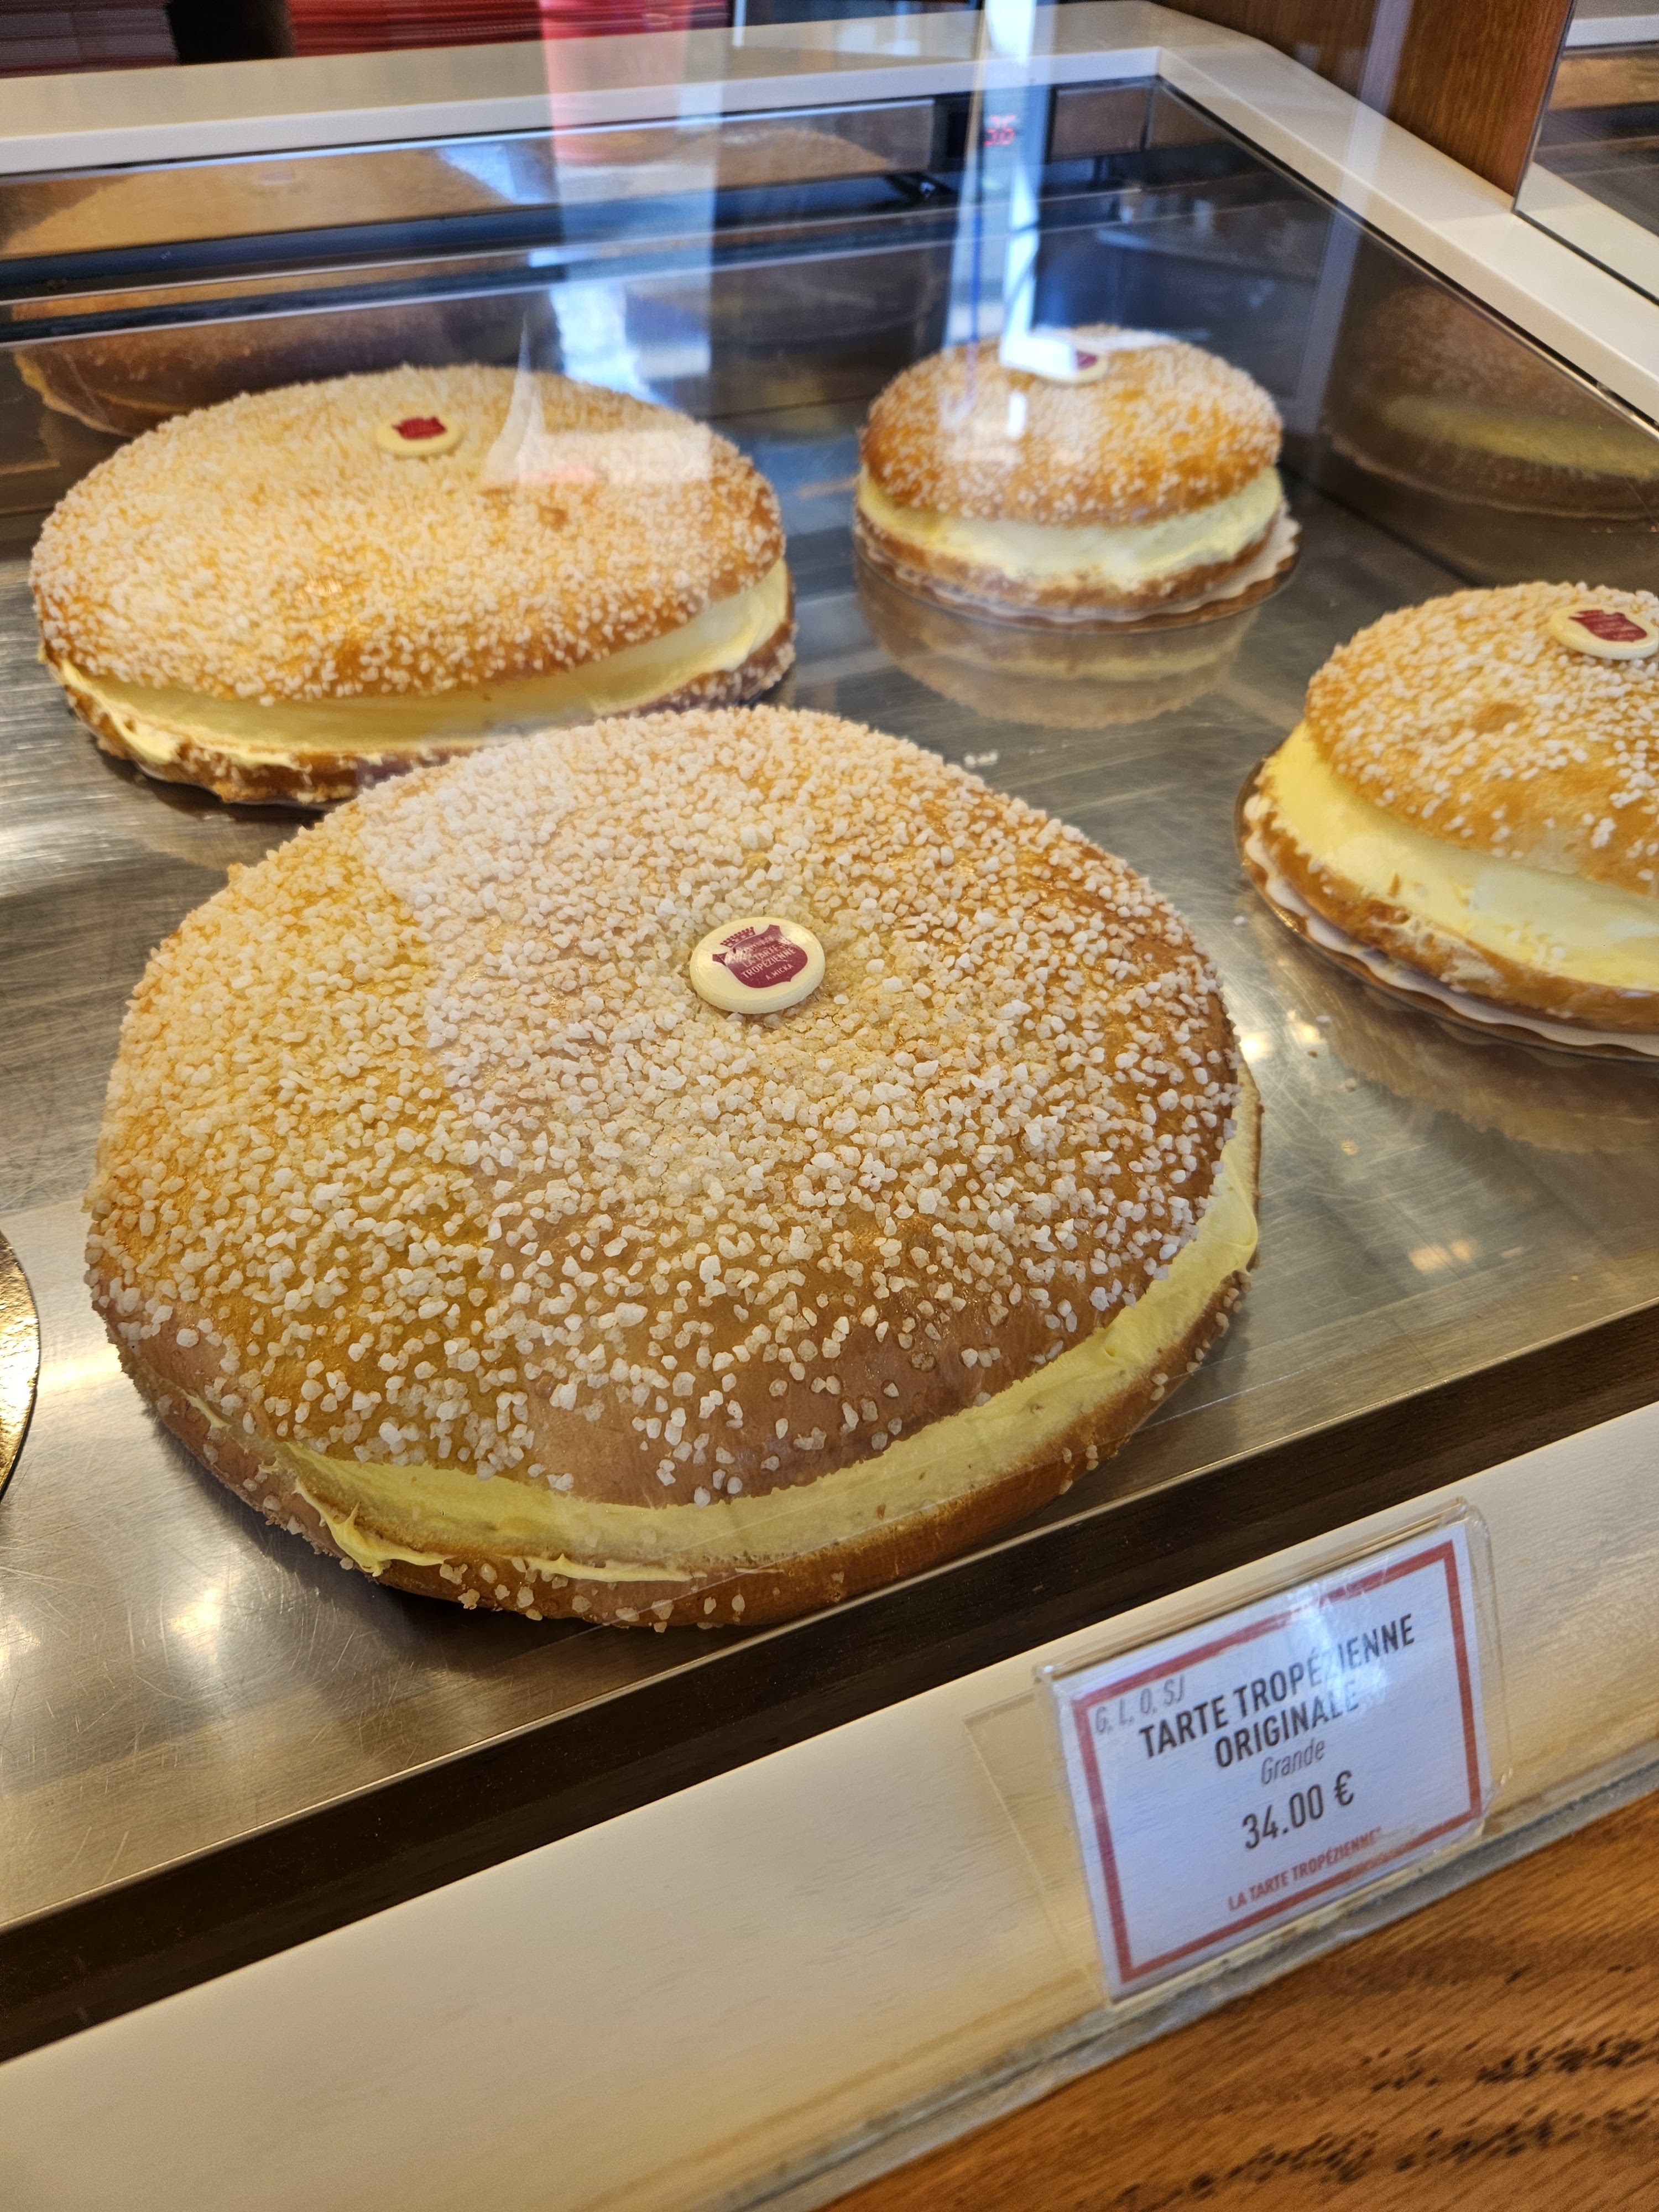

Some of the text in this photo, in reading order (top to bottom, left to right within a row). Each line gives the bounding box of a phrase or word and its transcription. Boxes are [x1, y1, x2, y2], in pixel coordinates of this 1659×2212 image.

[742, 944, 780, 968] LA TARTE
[1139, 1694, 1229, 1759] TARTE
[1215, 1679, 1359, 1768] ORIGINALE
[1261, 1738, 1325, 1785] Grande
[1241, 1770, 1354, 1849] 34.00 €
[1228, 1891, 1248, 1911] LA
[1248, 1870, 1289, 1901] TARTE
